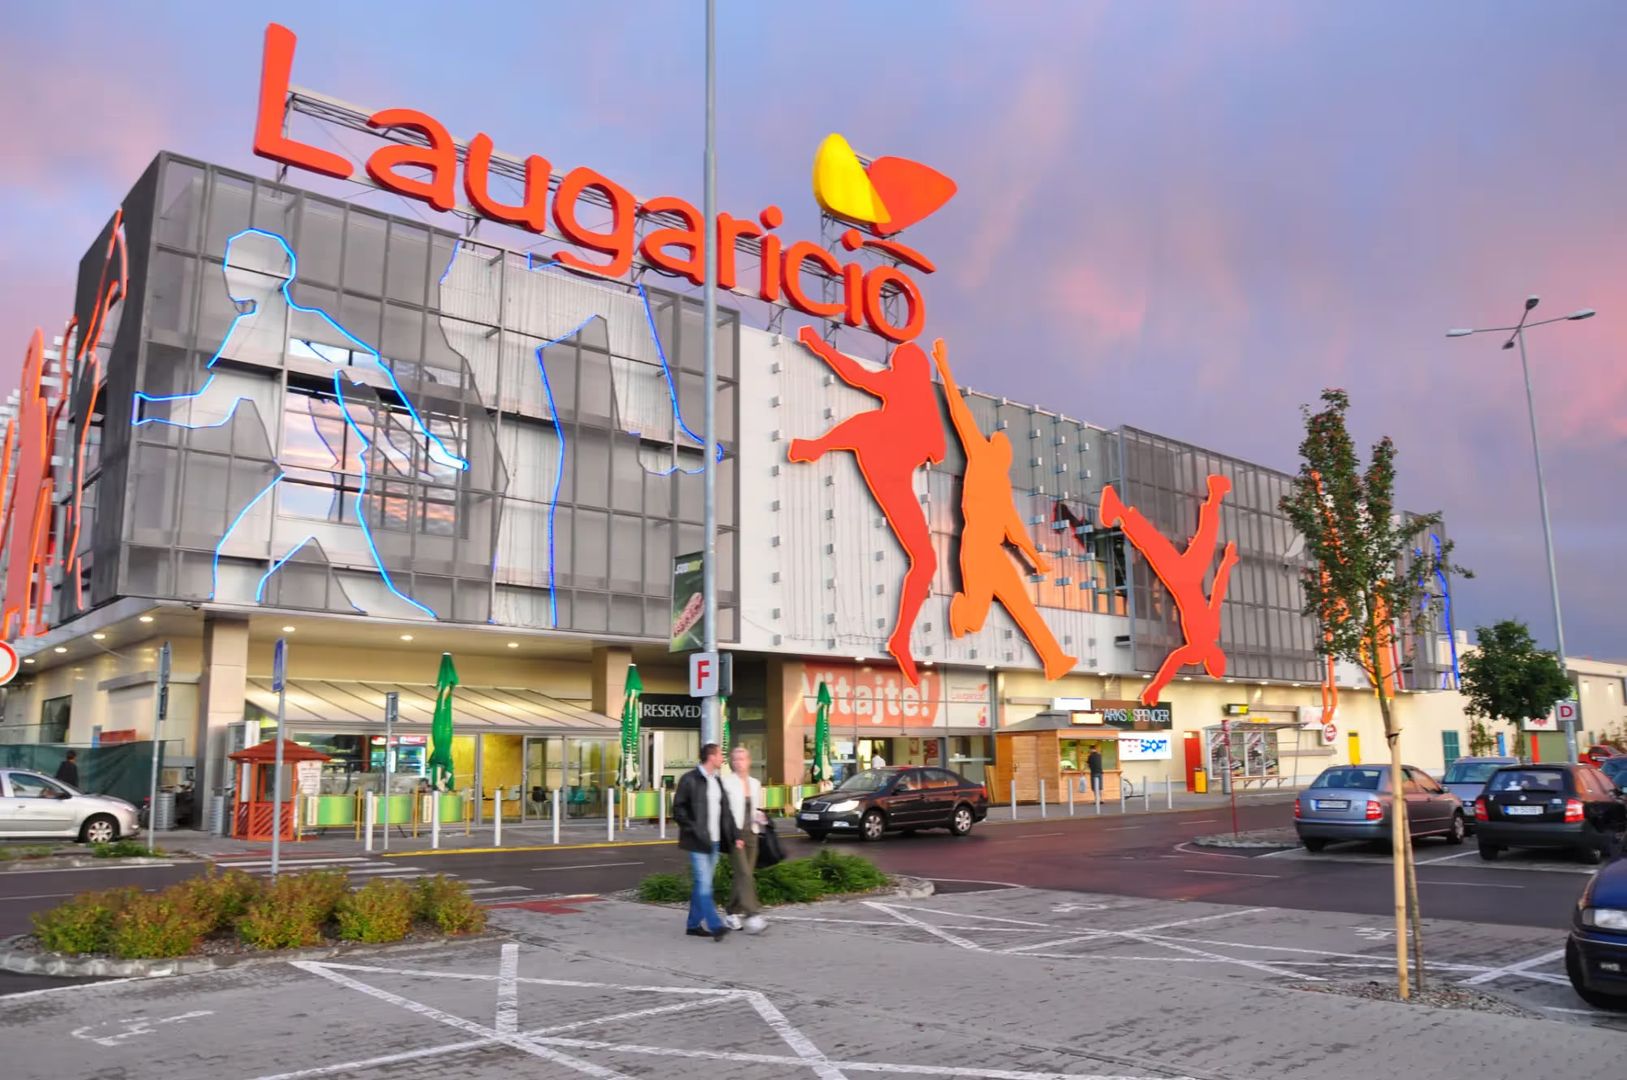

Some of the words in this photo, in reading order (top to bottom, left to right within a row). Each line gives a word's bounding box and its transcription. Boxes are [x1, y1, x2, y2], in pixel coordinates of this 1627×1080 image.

[697, 660, 710, 690] F
[643, 703, 702, 718] RESERVED
[1560, 705, 1573, 718] D
